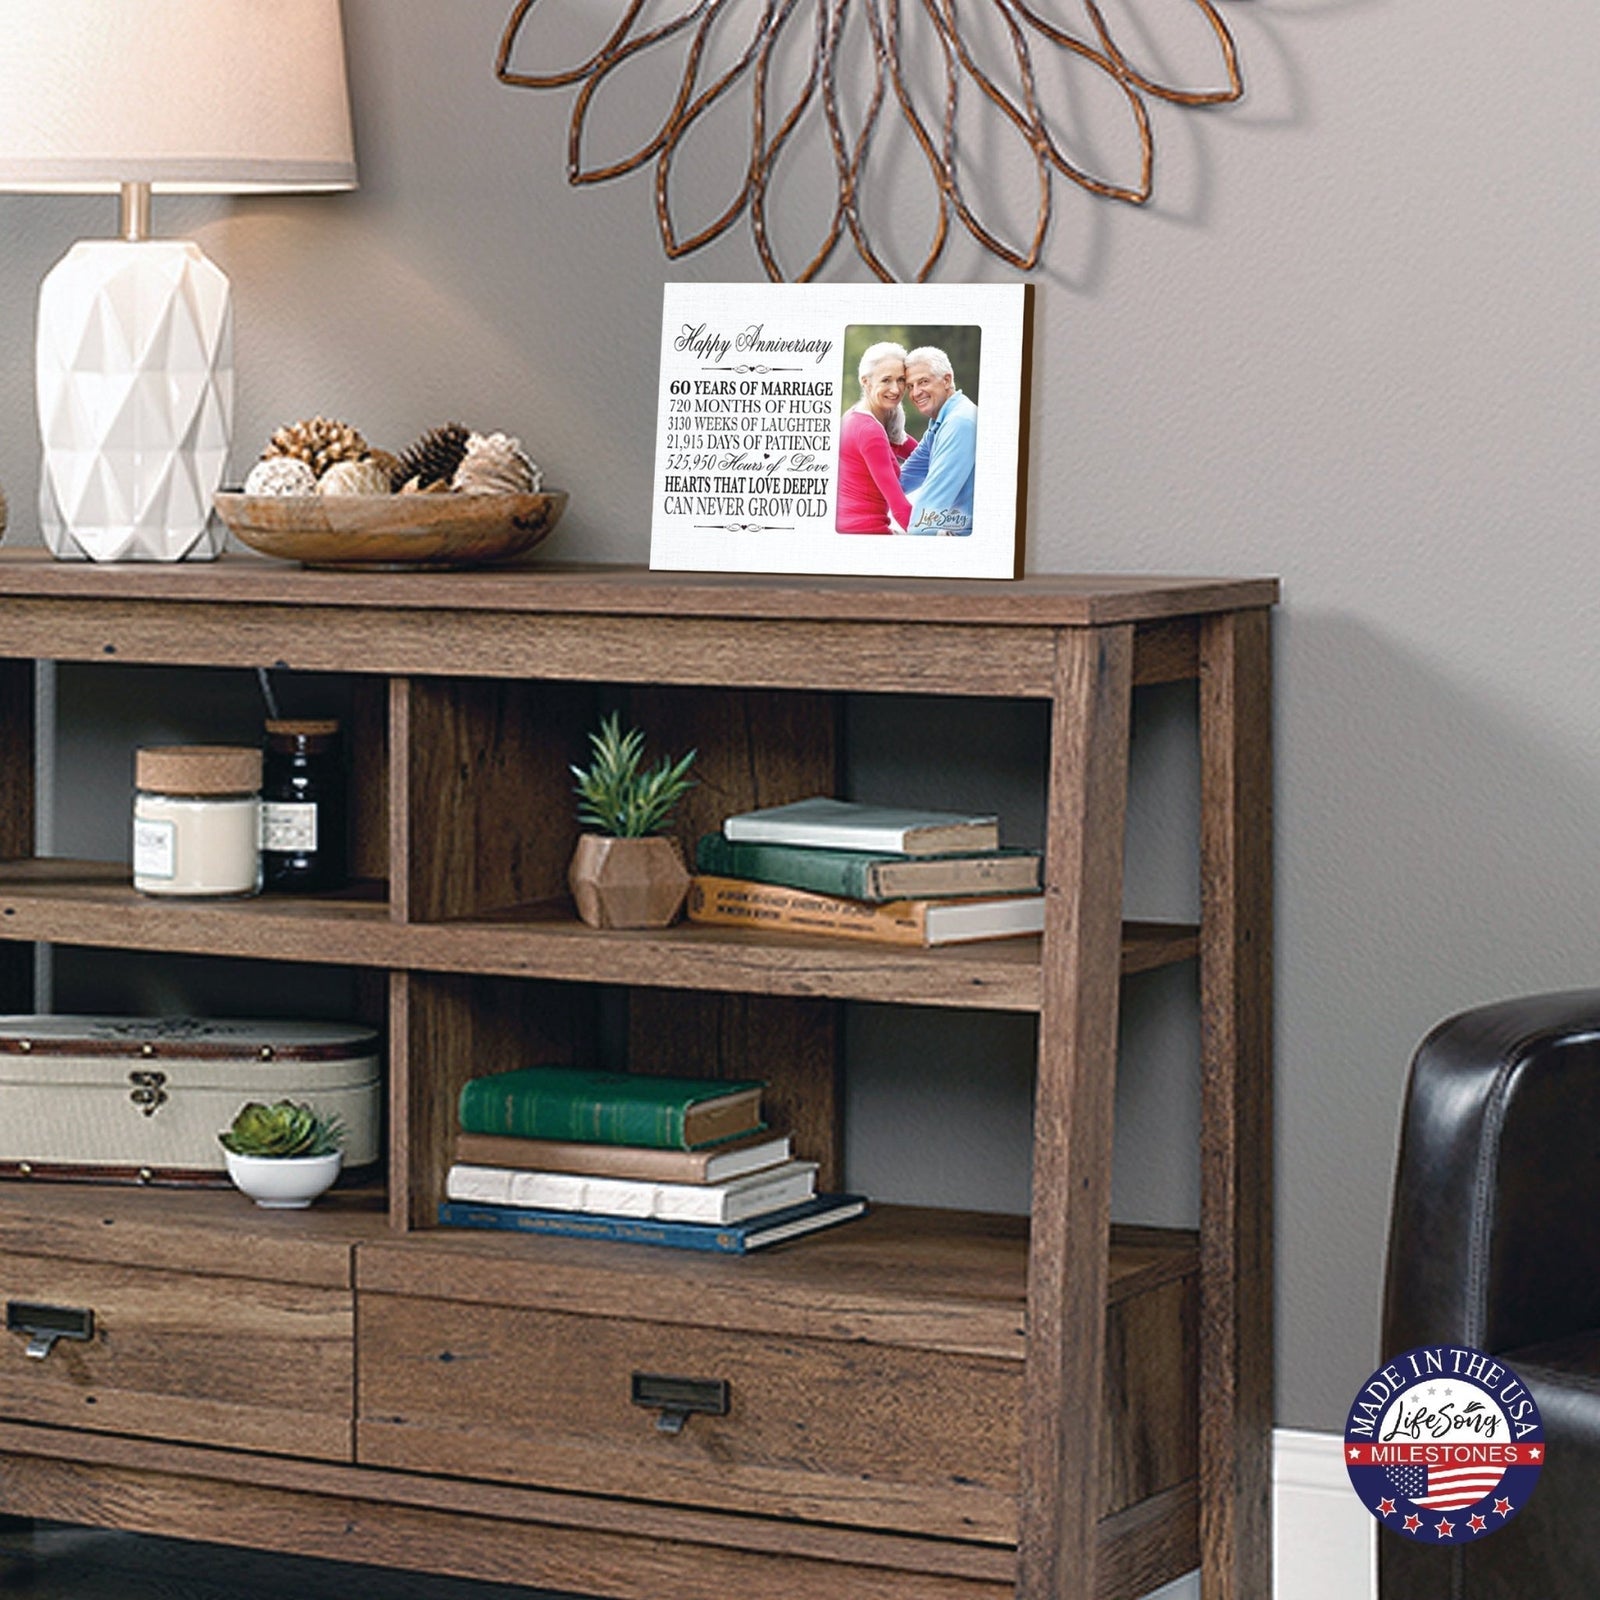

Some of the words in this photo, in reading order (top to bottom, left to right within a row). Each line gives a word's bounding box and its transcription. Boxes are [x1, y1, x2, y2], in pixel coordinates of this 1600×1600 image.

[674, 323, 731, 363] Happy
[735, 324, 832, 364] Anniversary
[670, 380, 691, 395] 60
[694, 381, 736, 395] YEARS
[739, 381, 758, 396] OF
[761, 381, 833, 396] MARRIAGE
[669, 399, 691, 412] 720
[694, 399, 761, 413] MONTHS
[765, 400, 786, 413] OF
[789, 400, 832, 414] HUGS
[668, 416, 691, 431] 3130
[695, 417, 738, 431] WEEKS
[741, 417, 758, 432] OF
[761, 417, 831, 432] LAUGHTER
[667, 434, 703, 451] 21,915
[707, 434, 740, 450] DAYS
[743, 435, 762, 450] OF
[765, 435, 831, 451] PATIENCE
[665, 453, 717, 471] 525,950
[717, 452, 764, 471] Hours
[766, 455, 787, 476] of
[786, 453, 830, 472] Love
[664, 476, 711, 493] HEARTS
[713, 476, 746, 493] THAT
[749, 477, 781, 494] LOVE
[782, 477, 829, 495] DEEPLY
[664, 496, 693, 515] CAN
[696, 496, 745, 516] NEVER
[748, 497, 793, 517] GROW
[796, 498, 828, 517] OLD
[914, 508, 967, 528] LifeSong
